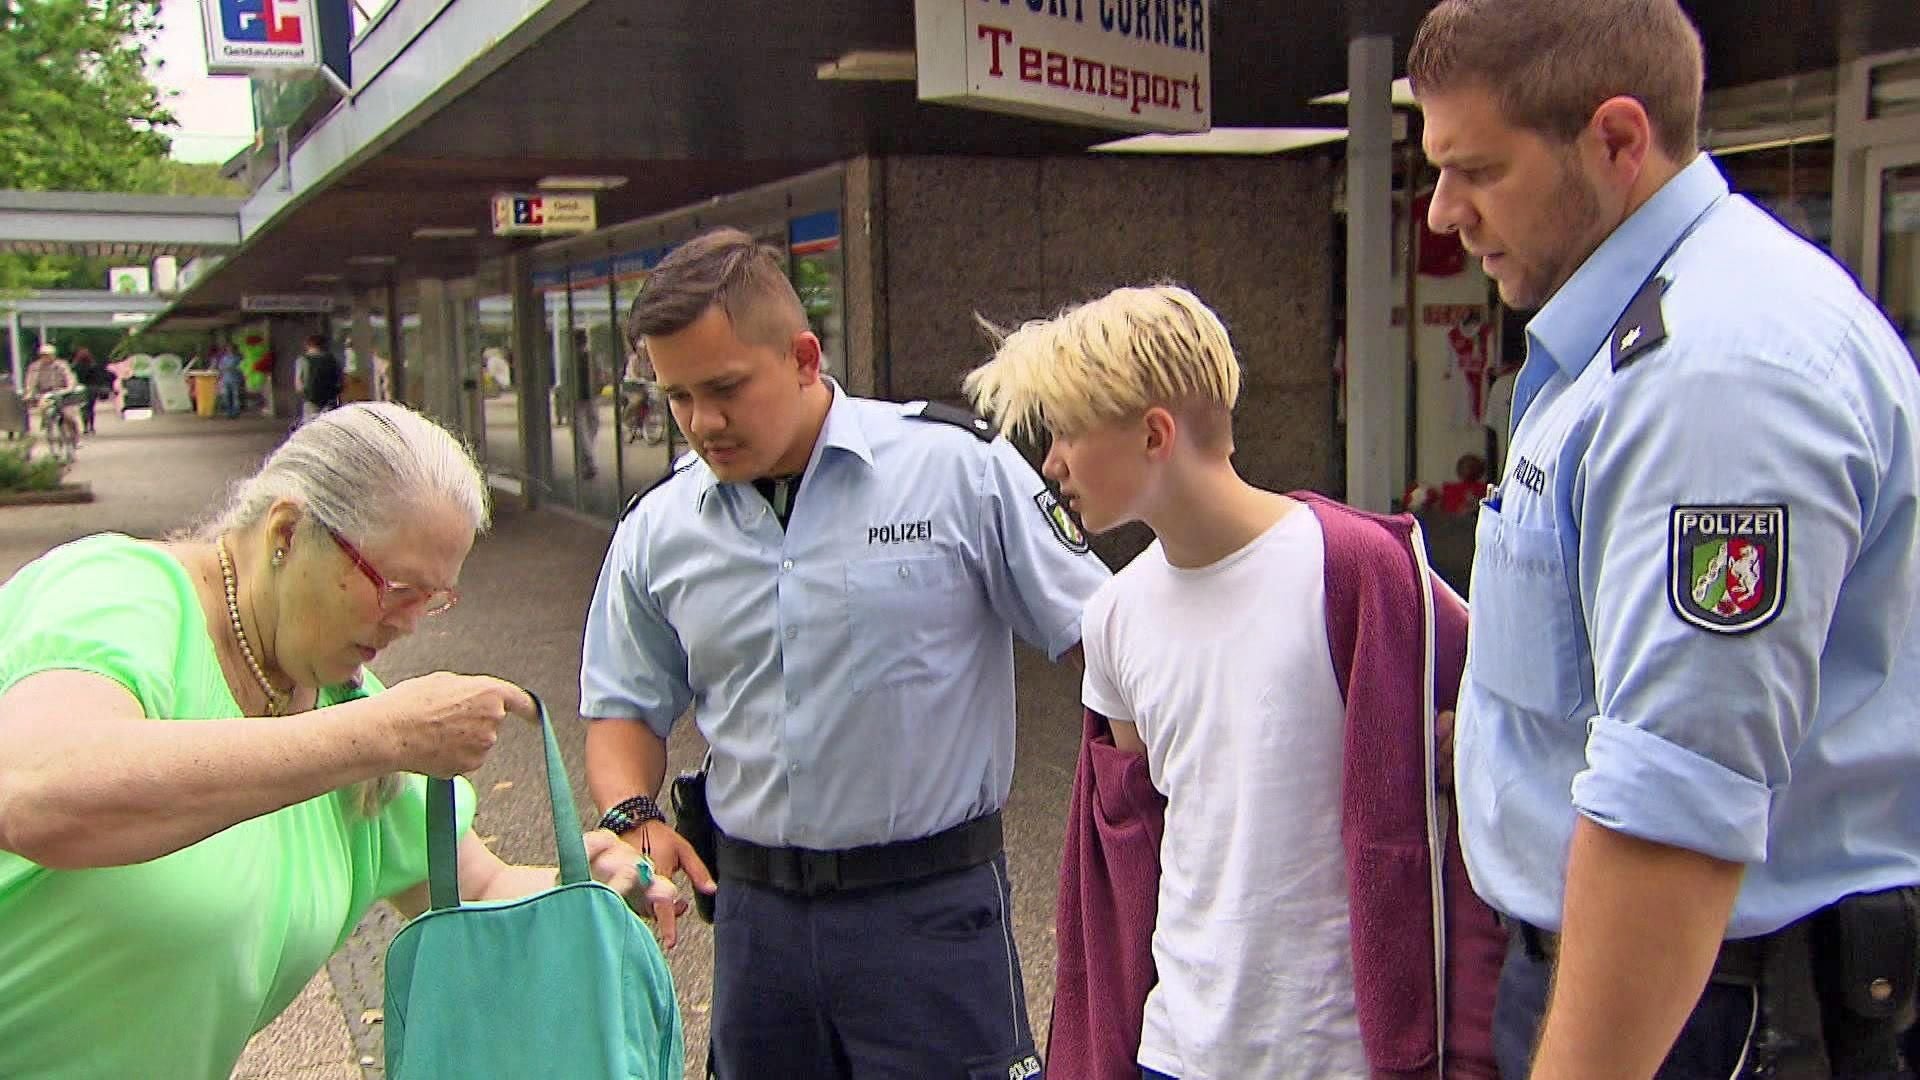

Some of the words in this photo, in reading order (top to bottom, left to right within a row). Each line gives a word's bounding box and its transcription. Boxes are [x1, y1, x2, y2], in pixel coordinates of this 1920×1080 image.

[224, 45, 305, 57] Geldautomat
[978, 24, 1203, 114] Teamsport
[868, 519, 932, 544] POLIZEI
[1683, 514, 1775, 535] POLIZEI
